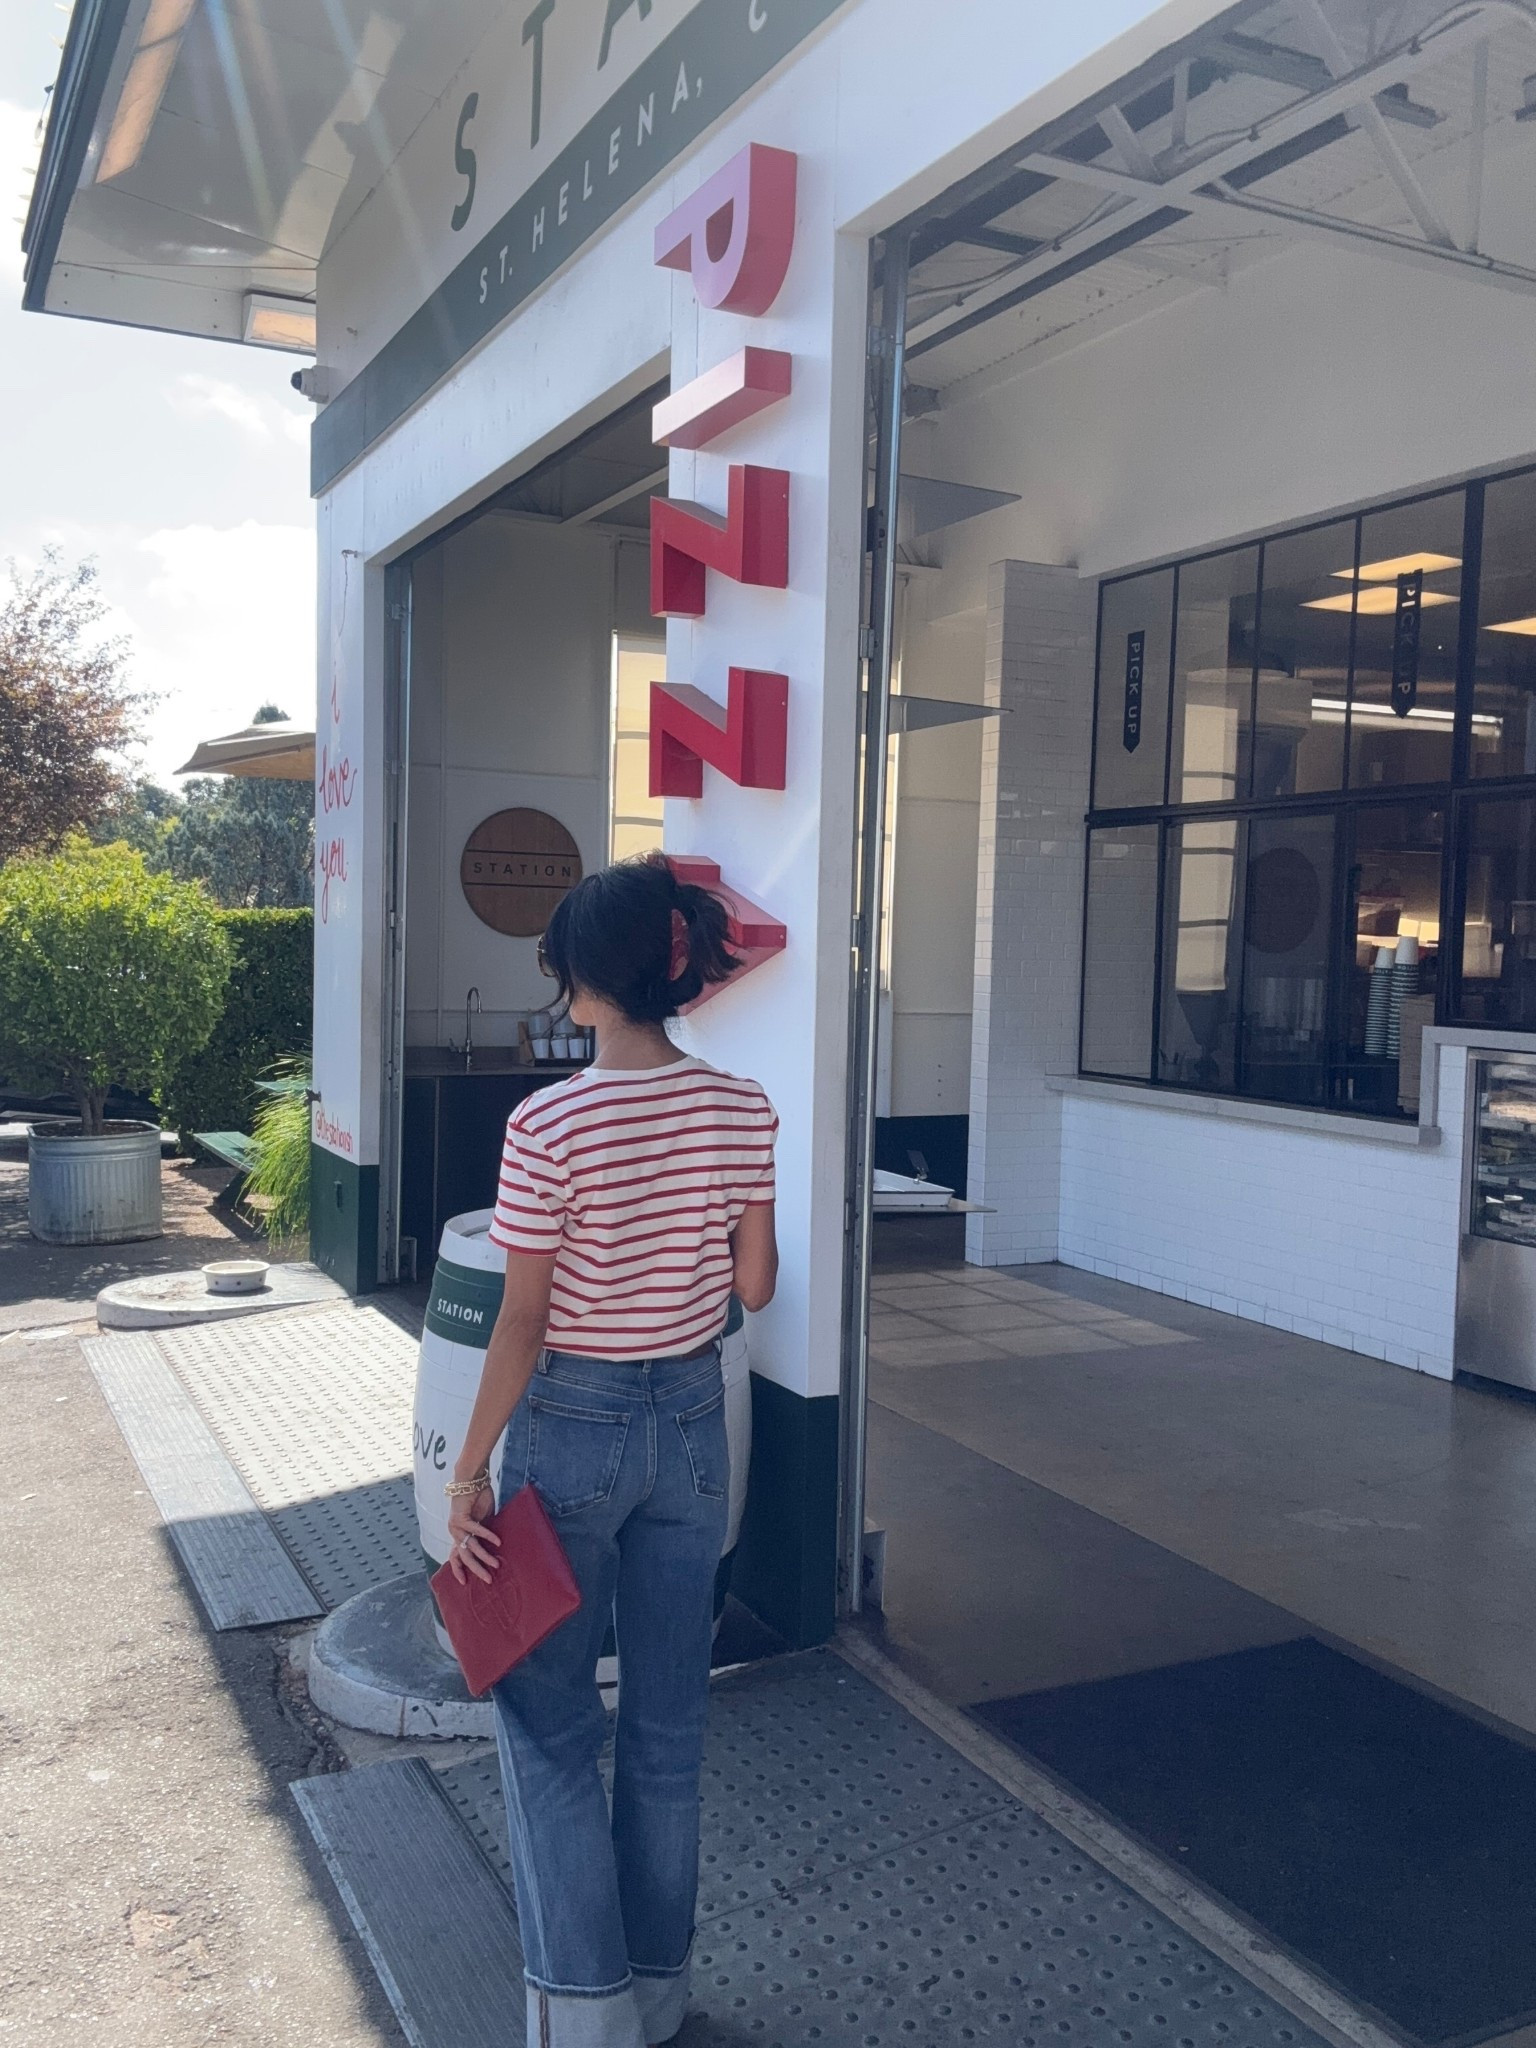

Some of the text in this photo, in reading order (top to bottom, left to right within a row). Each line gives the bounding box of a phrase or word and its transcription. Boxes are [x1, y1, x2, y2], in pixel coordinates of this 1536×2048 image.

[480, 245, 513, 304] ST.
[532, 61, 703, 253] HELENA,
[1127, 641, 1142, 734] PICK UP
[318, 743, 358, 814] love
[472, 861, 572, 878] STATION
[437, 1297, 485, 1325] STATION
